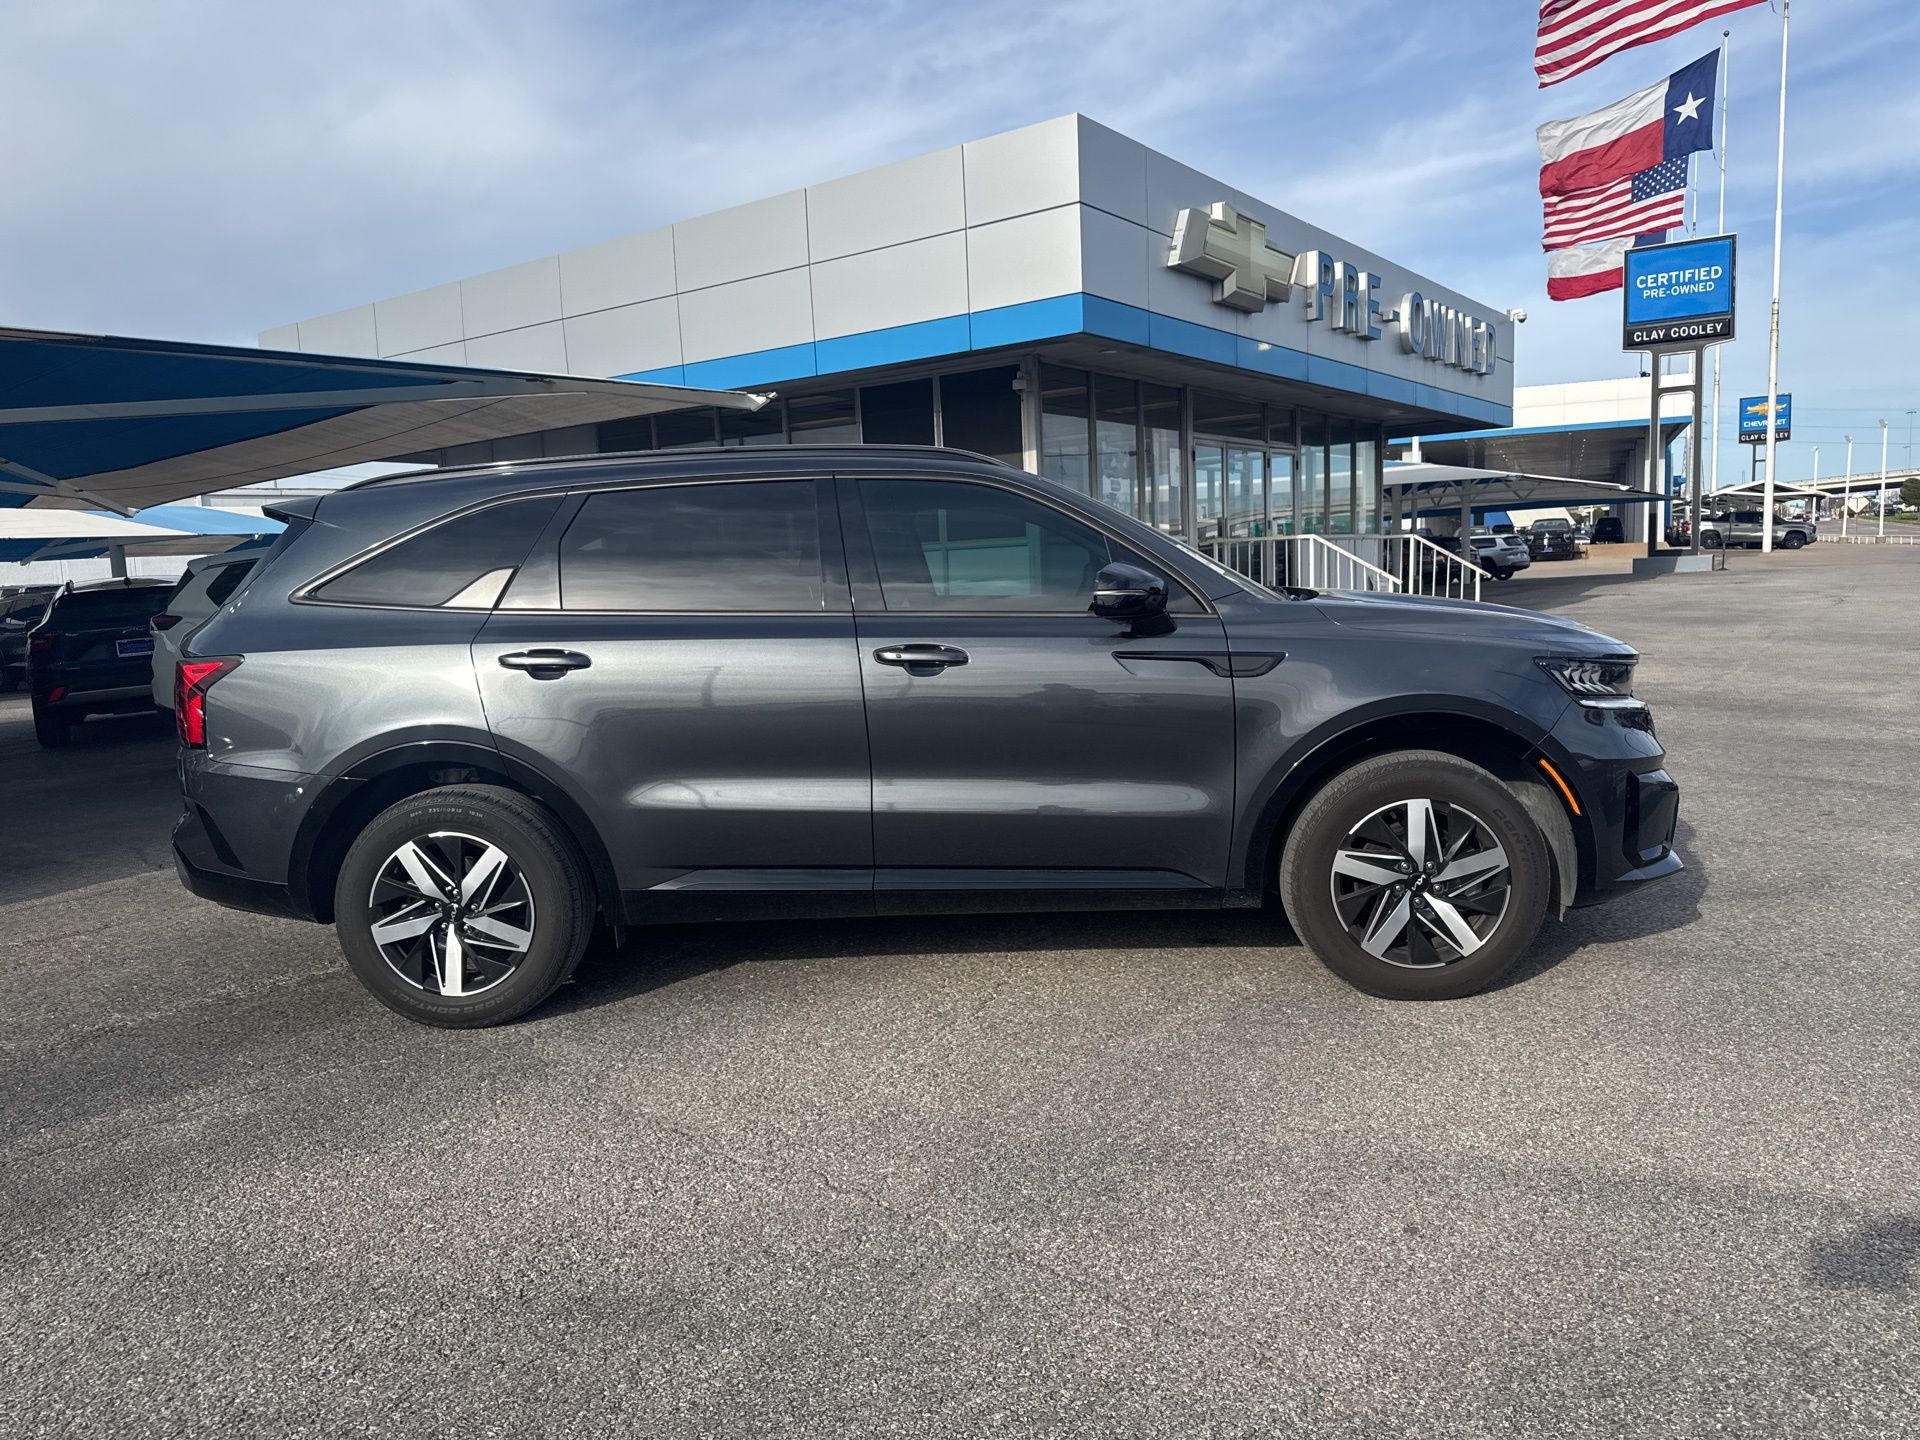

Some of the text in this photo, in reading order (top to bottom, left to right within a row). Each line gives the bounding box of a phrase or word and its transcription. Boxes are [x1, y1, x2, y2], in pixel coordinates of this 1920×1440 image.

[1636, 265, 1722, 288] CERTIFIED
[1643, 281, 1715, 299] PRE-OWNED
[1307, 250, 1497, 375] PRE-OWNED
[1634, 323, 1723, 341] CLAY COOLEY
[1743, 418, 1787, 427] CHEVRET
[1760, 432, 1788, 440] CLEY
